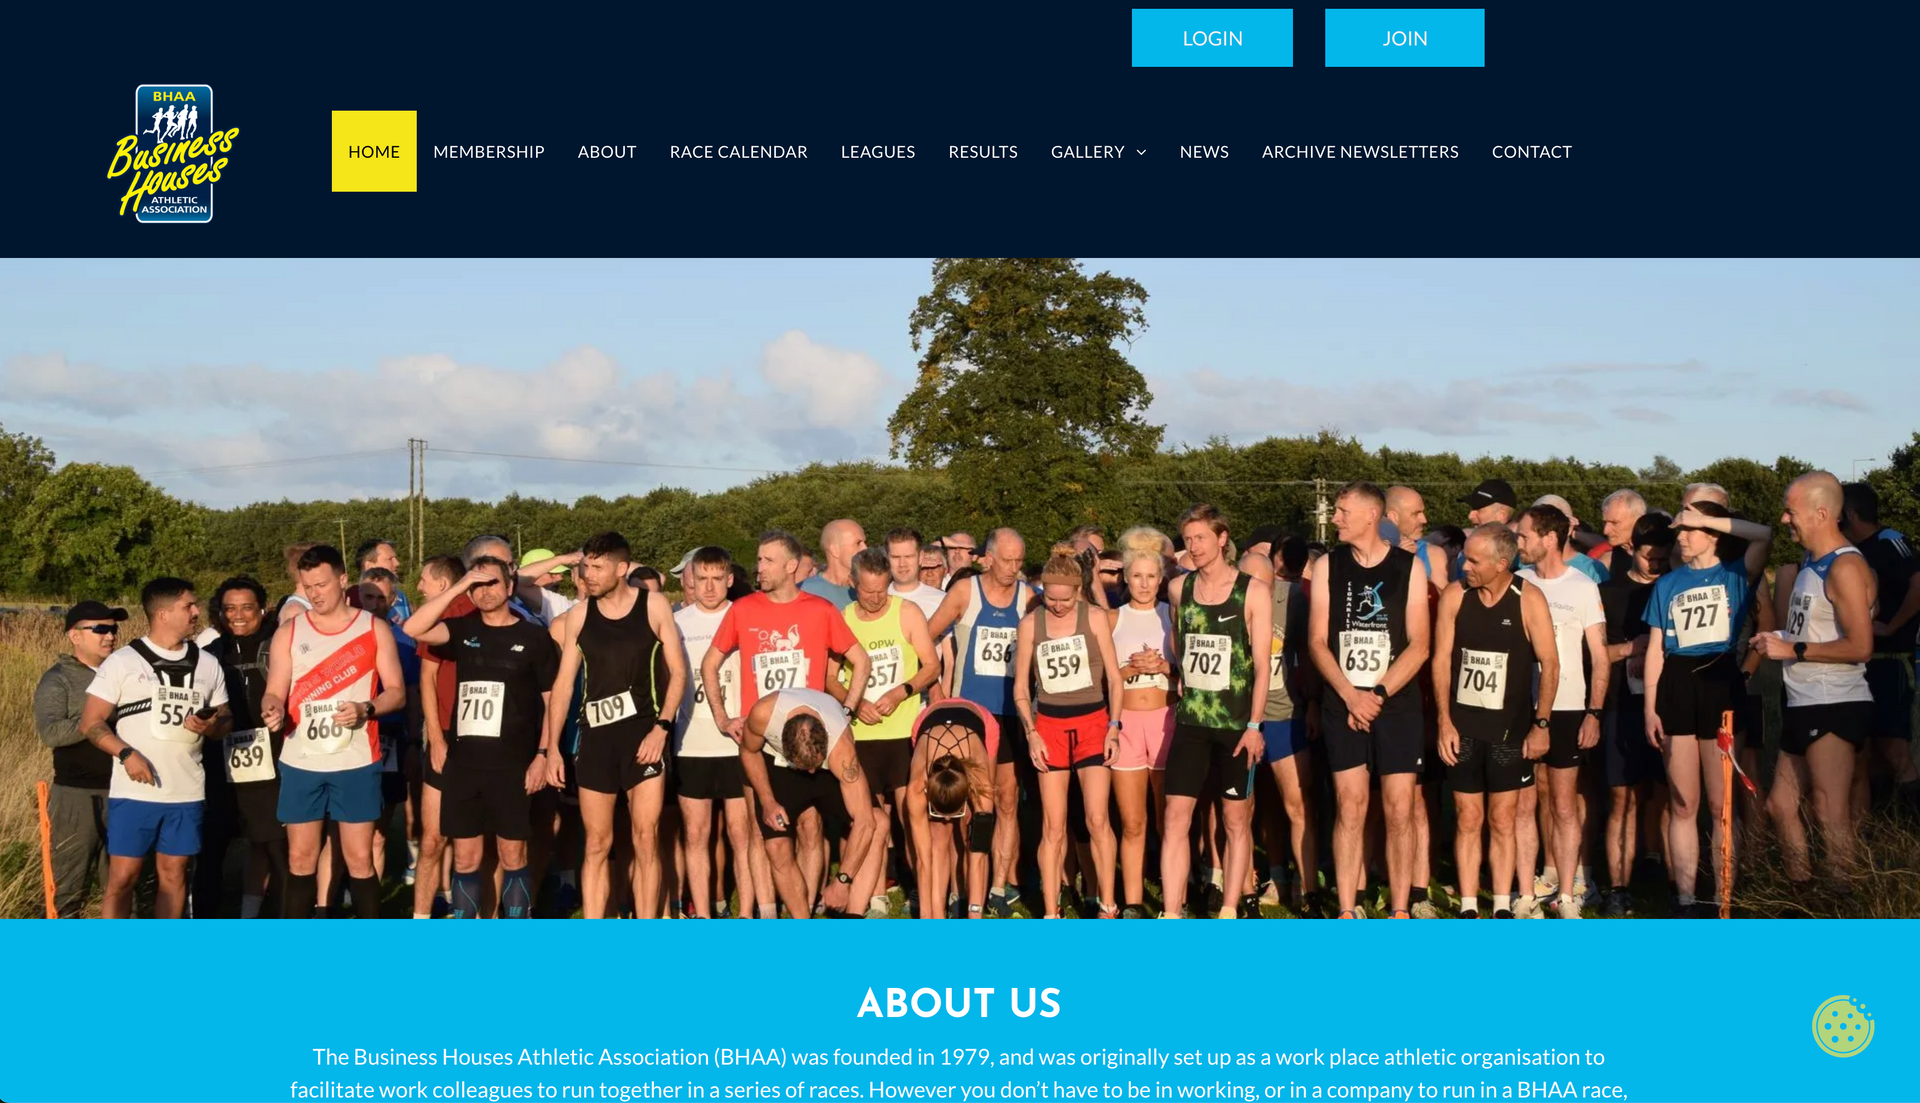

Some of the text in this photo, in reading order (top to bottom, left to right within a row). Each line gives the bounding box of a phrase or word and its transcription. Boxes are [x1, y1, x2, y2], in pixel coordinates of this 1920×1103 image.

[1184, 31, 1242, 46] LOGIN
[1383, 31, 1427, 46] JOIN
[153, 91, 196, 102] BHAA
[107, 127, 240, 179] Business
[349, 145, 400, 158] HOME
[434, 145, 544, 158] MEMBERSHIP
[578, 145, 637, 158] ABOUT
[671, 145, 808, 158] RACE CALENDAR
[842, 145, 915, 158] LEAGUES
[950, 145, 1018, 158] RESULTS
[1051, 145, 1125, 158] GALLERY
[1181, 145, 1229, 158] NEWS
[1262, 145, 1459, 158] ARCHIVE NEWSLETTERS
[1492, 145, 1572, 158] CONTACT
[119, 157, 229, 216] Houses
[151, 196, 198, 204] ATHLETIC
[141, 206, 208, 214] ASSOCIATION
[1687, 592, 1708, 603] BHAA
[1351, 620, 1387, 628] Waterfront
[1681, 604, 1719, 631] 727
[1788, 610, 1805, 636] 29
[990, 631, 1008, 639] BHAA
[1354, 636, 1374, 645] BHAA
[869, 639, 895, 650] OPW
[1051, 643, 1070, 653] BHAA
[1196, 639, 1215, 648] BHAA
[982, 642, 1012, 663] 636
[770, 656, 789, 665] BHAA
[1190, 652, 1221, 675] 702
[1346, 649, 1381, 671] 635
[1471, 656, 1491, 666] BHAA
[1047, 654, 1081, 680] 559
[333, 665, 357, 684] CLUB
[765, 668, 797, 691] 697
[1463, 668, 1498, 694] 704
[169, 691, 189, 702] BHAA
[469, 687, 487, 695] BHAA
[694, 684, 727, 704] 64
[313, 704, 333, 713] BHAA
[461, 699, 494, 721] 710
[591, 695, 625, 724] 709
[307, 717, 343, 740] 666
[231, 745, 264, 769] 639
[857, 987, 1060, 1018] ABOUT US
[313, 1048, 1605, 1069] The Business Houses Athletic Association (BHAA) was founded in 1979, and was originally set up as a work place athletic organisation to
[290, 1081, 1627, 1102] facilitate work colleagues to run together in a series of races. However you don’t have to be in working, or in a company to run in a BHAA race,
